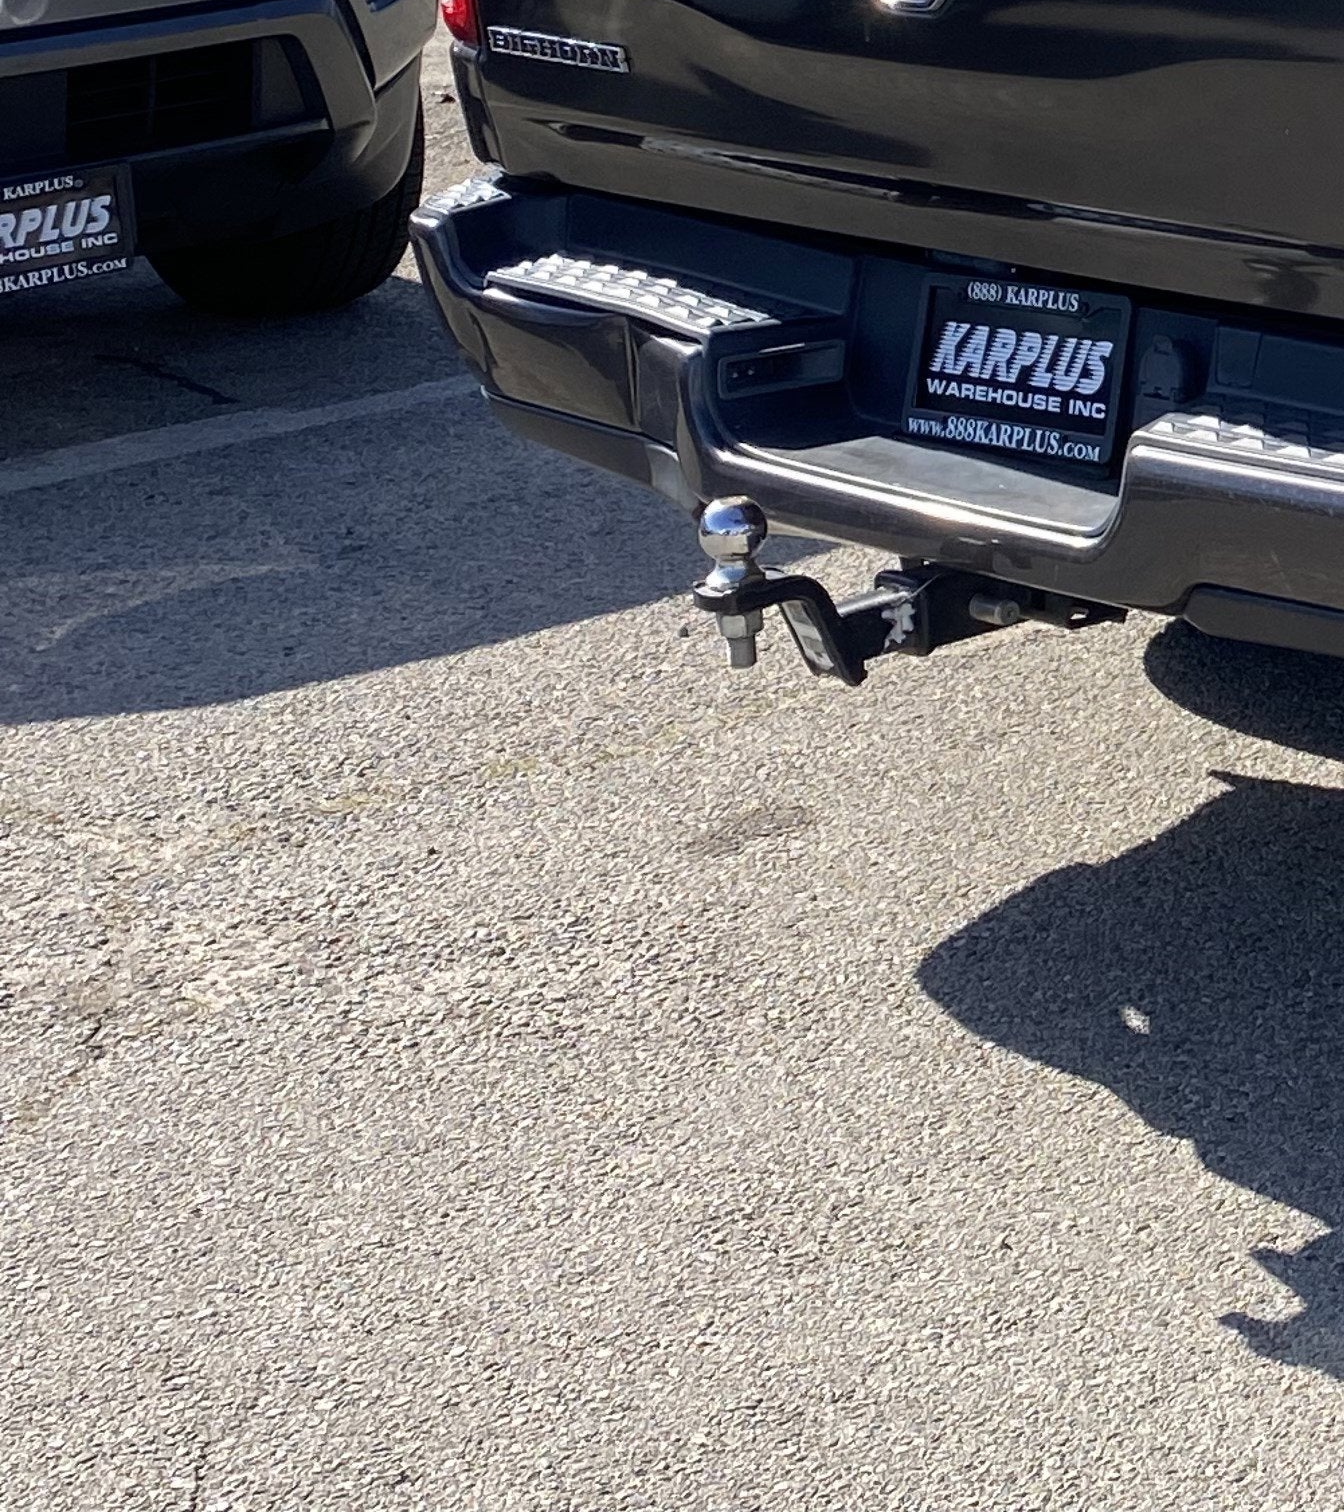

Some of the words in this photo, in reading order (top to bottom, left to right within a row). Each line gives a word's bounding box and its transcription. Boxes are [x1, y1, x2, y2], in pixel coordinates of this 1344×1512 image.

[3, 175, 74, 201] KARPLUS
[81, 232, 118, 249] INC
[967, 282, 1002, 303] (888)
[1005, 285, 1079, 312] KARPLUS
[928, 321, 1114, 395] KARPLUS
[926, 378, 1062, 414] WAREHOUSE
[1068, 398, 1106, 419] INC
